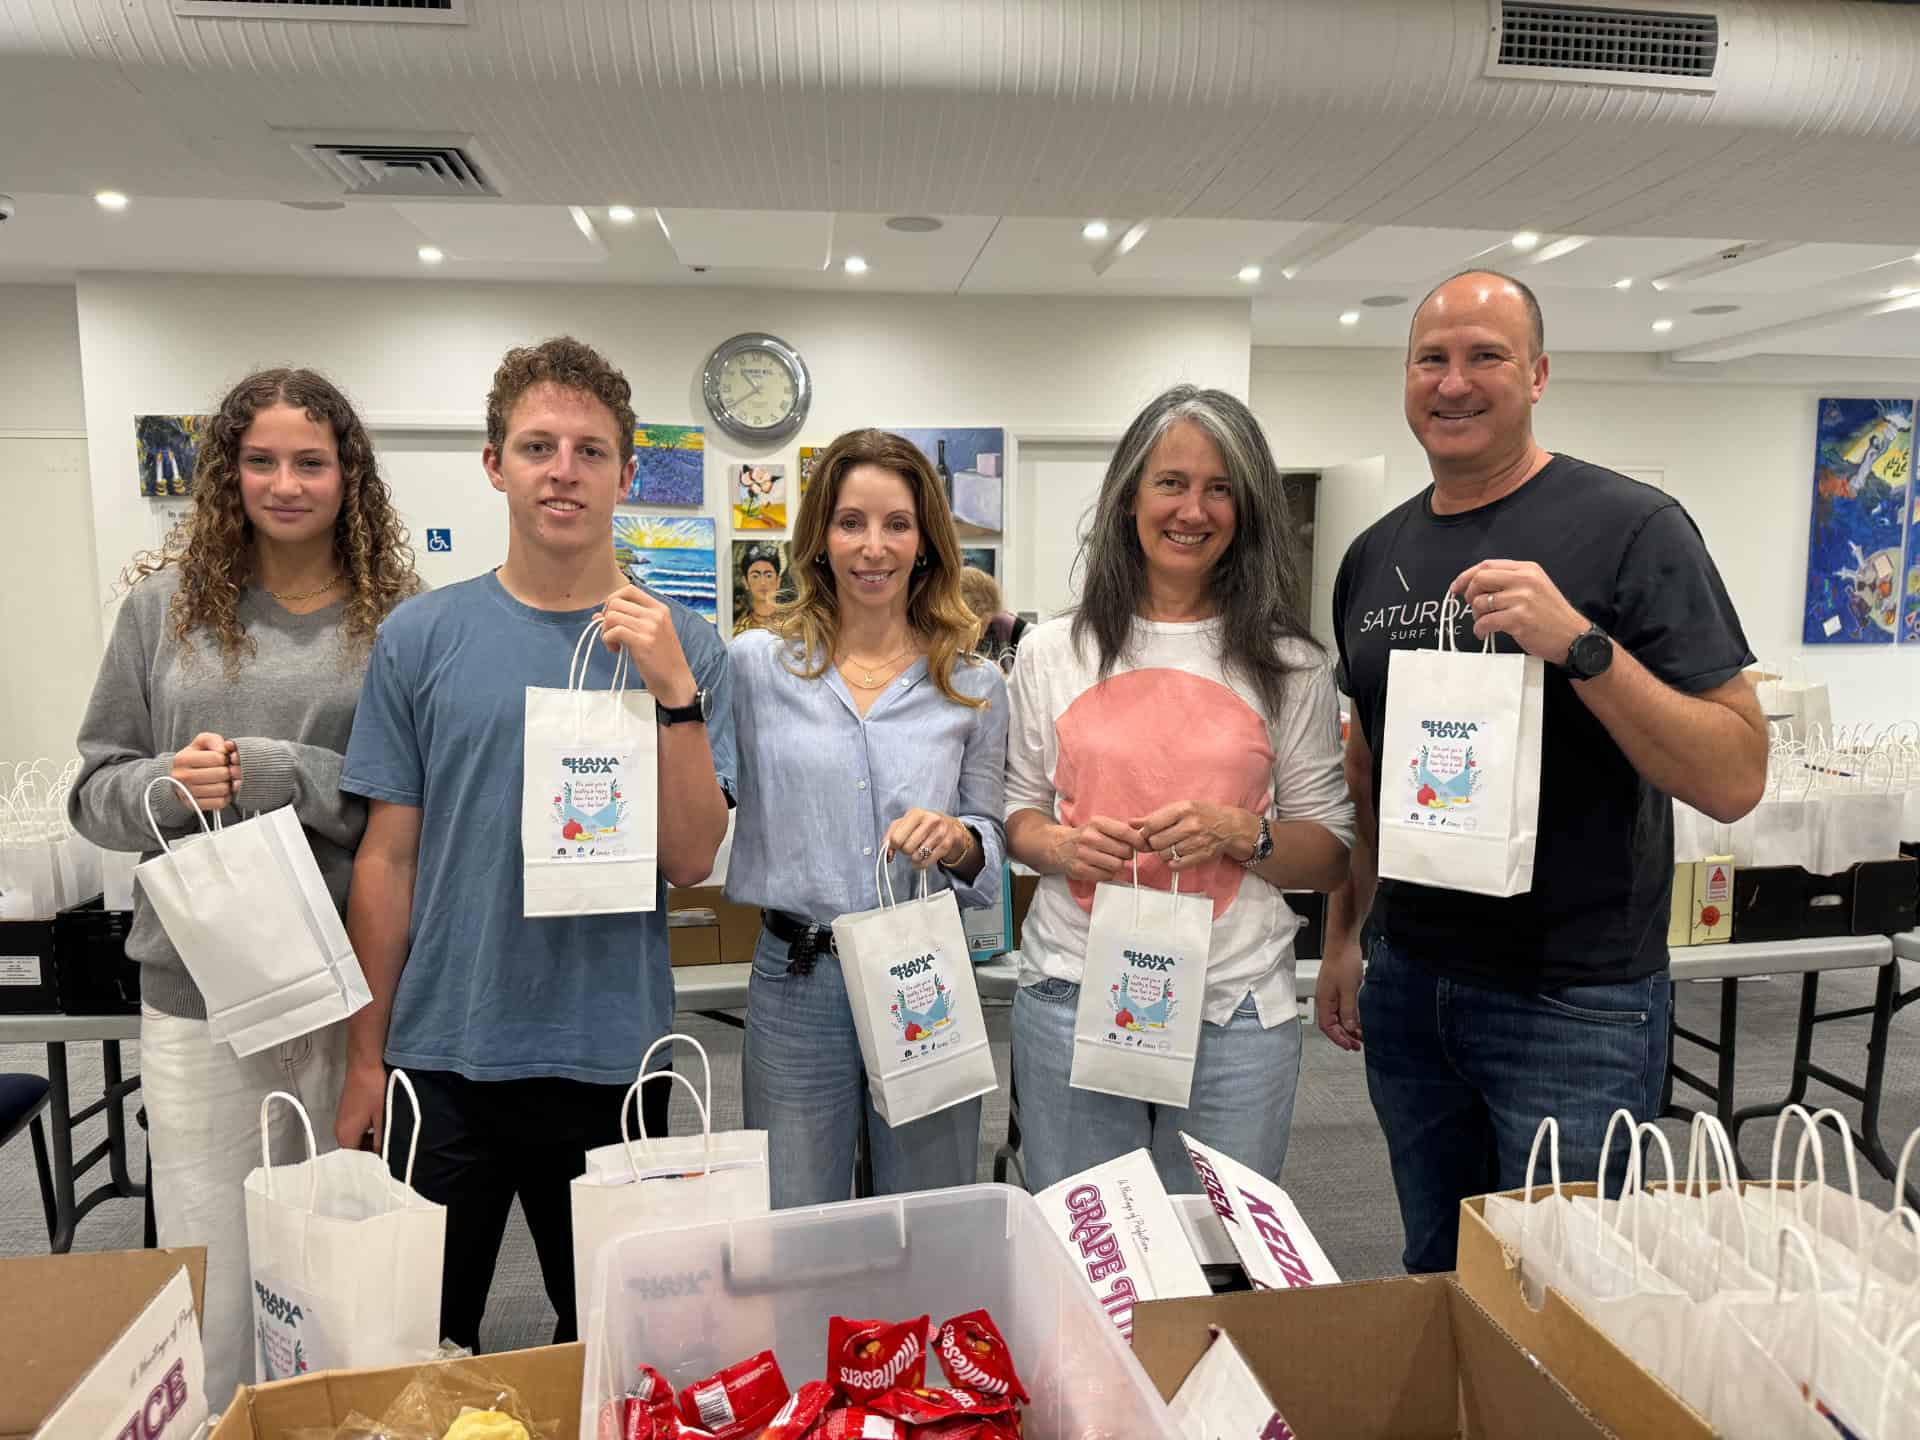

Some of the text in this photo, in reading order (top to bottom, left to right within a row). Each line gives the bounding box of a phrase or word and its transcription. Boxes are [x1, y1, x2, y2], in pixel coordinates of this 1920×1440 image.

[1391, 628, 1427, 640] SURF
[1421, 720, 1478, 732] SHANA
[1428, 728, 1470, 740] TOVA
[561, 757, 620, 766] SHANA
[569, 765, 613, 774] TOVA
[889, 953, 935, 976] SHANA
[1123, 950, 1175, 966] SHANA
[1129, 958, 1168, 972] TOVA
[897, 962, 932, 980] TOVA
[1066, 1184, 1127, 1283] GRAPE
[1237, 1186, 1314, 1288] KED
[261, 1297, 297, 1328] TOVA
